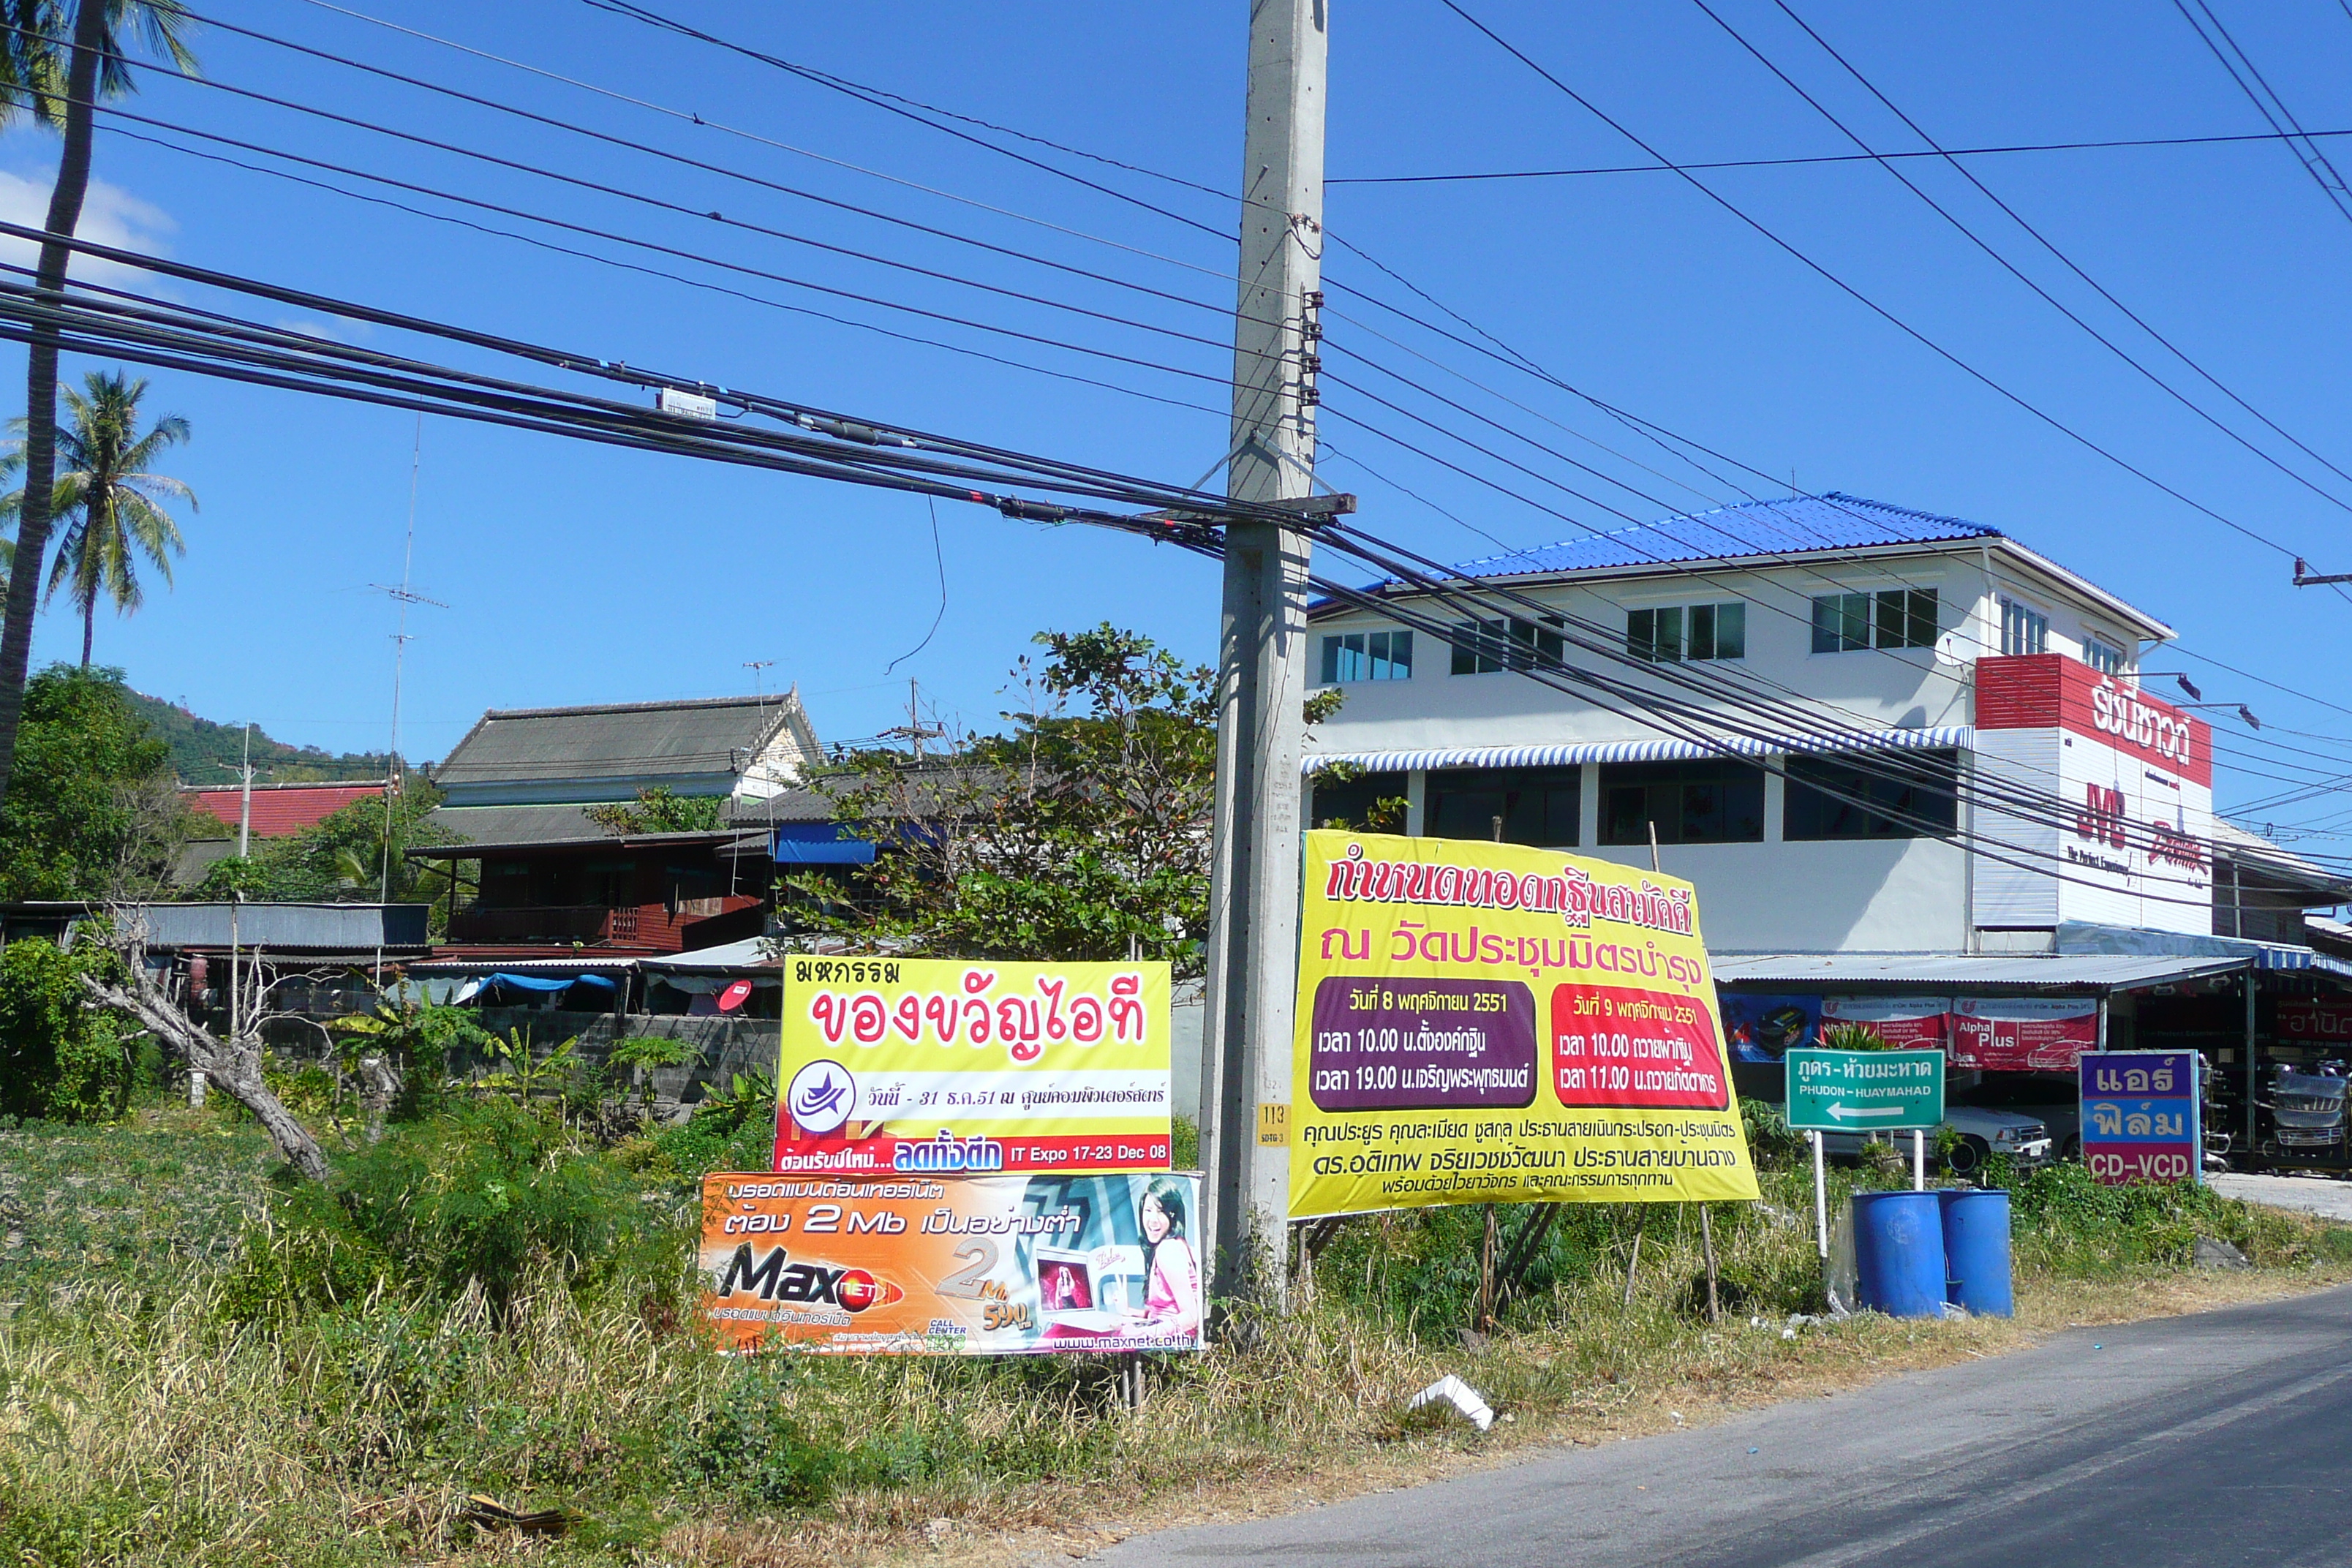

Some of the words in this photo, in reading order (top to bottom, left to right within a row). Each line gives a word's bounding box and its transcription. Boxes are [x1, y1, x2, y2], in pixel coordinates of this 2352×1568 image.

[1325, 843, 1693, 937] กำหนดทอดกฐินสามัคคี
[1320, 928, 1371, 960] ณ
[1390, 919, 1703, 993] วัดประชุมมิตรบำรุง
[796, 960, 900, 983] มหกรรม
[1349, 984, 1379, 1011] วันที่
[1382, 991, 1394, 1011] 8
[1398, 990, 1469, 1014] พฤศจิกายน
[1473, 992, 1507, 1012] 2551
[1573, 992, 1600, 1016] วันที่
[1605, 998, 1613, 1017] 9
[1674, 1005, 1699, 1025] 2551
[812, 971, 1143, 1061] ของขวัญไอที
[1959, 1022, 1990, 1034] Alpha
[1318, 1030, 1352, 1052] เวลา
[1357, 1028, 1398, 1052] 10.00
[1558, 1034, 1586, 1056] เวลา
[1591, 1033, 1629, 1058] 10.00
[1978, 1022, 2015, 1047] Plus
[1315, 1068, 1350, 1091] เวลา
[1355, 1066, 1397, 1090] 19.00
[1559, 1067, 1586, 1089] เวลา
[1590, 1065, 1629, 1090] 11.00
[2096, 1056, 2176, 1092] แอร์
[867, 1082, 906, 1106] วันนี้
[919, 1091, 938, 1106] 31
[1264, 1105, 1284, 1125] 113
[2092, 1101, 2183, 1135] ฟิล์ม
[1303, 1122, 1383, 1147] คุณประยูร
[894, 1128, 1003, 1171] ลดทั้งตึก
[1011, 1147, 1026, 1162] IT
[1030, 1147, 1068, 1164] Expo
[1073, 1145, 1113, 1161] 17-23
[1117, 1145, 1145, 1160] Dec
[1149, 1144, 1166, 1159] 08
[1313, 1150, 1422, 1175] ดร.อติเทพ
[1573, 1139, 1736, 1168] ประธานสายบ้านฉาง
[2090, 1153, 2188, 1177] CD-VCD
[728, 1178, 944, 1199] บรอดแบนด์อินเทอร์เน็ต
[724, 1204, 791, 1234] ต้อง
[803, 1205, 843, 1233] 2
[846, 1210, 907, 1234] Mb
[920, 1205, 1082, 1234] เป็นอย่างต่ำ
[935, 1237, 999, 1301] 2
[928, 1327, 967, 1335] CENTER
